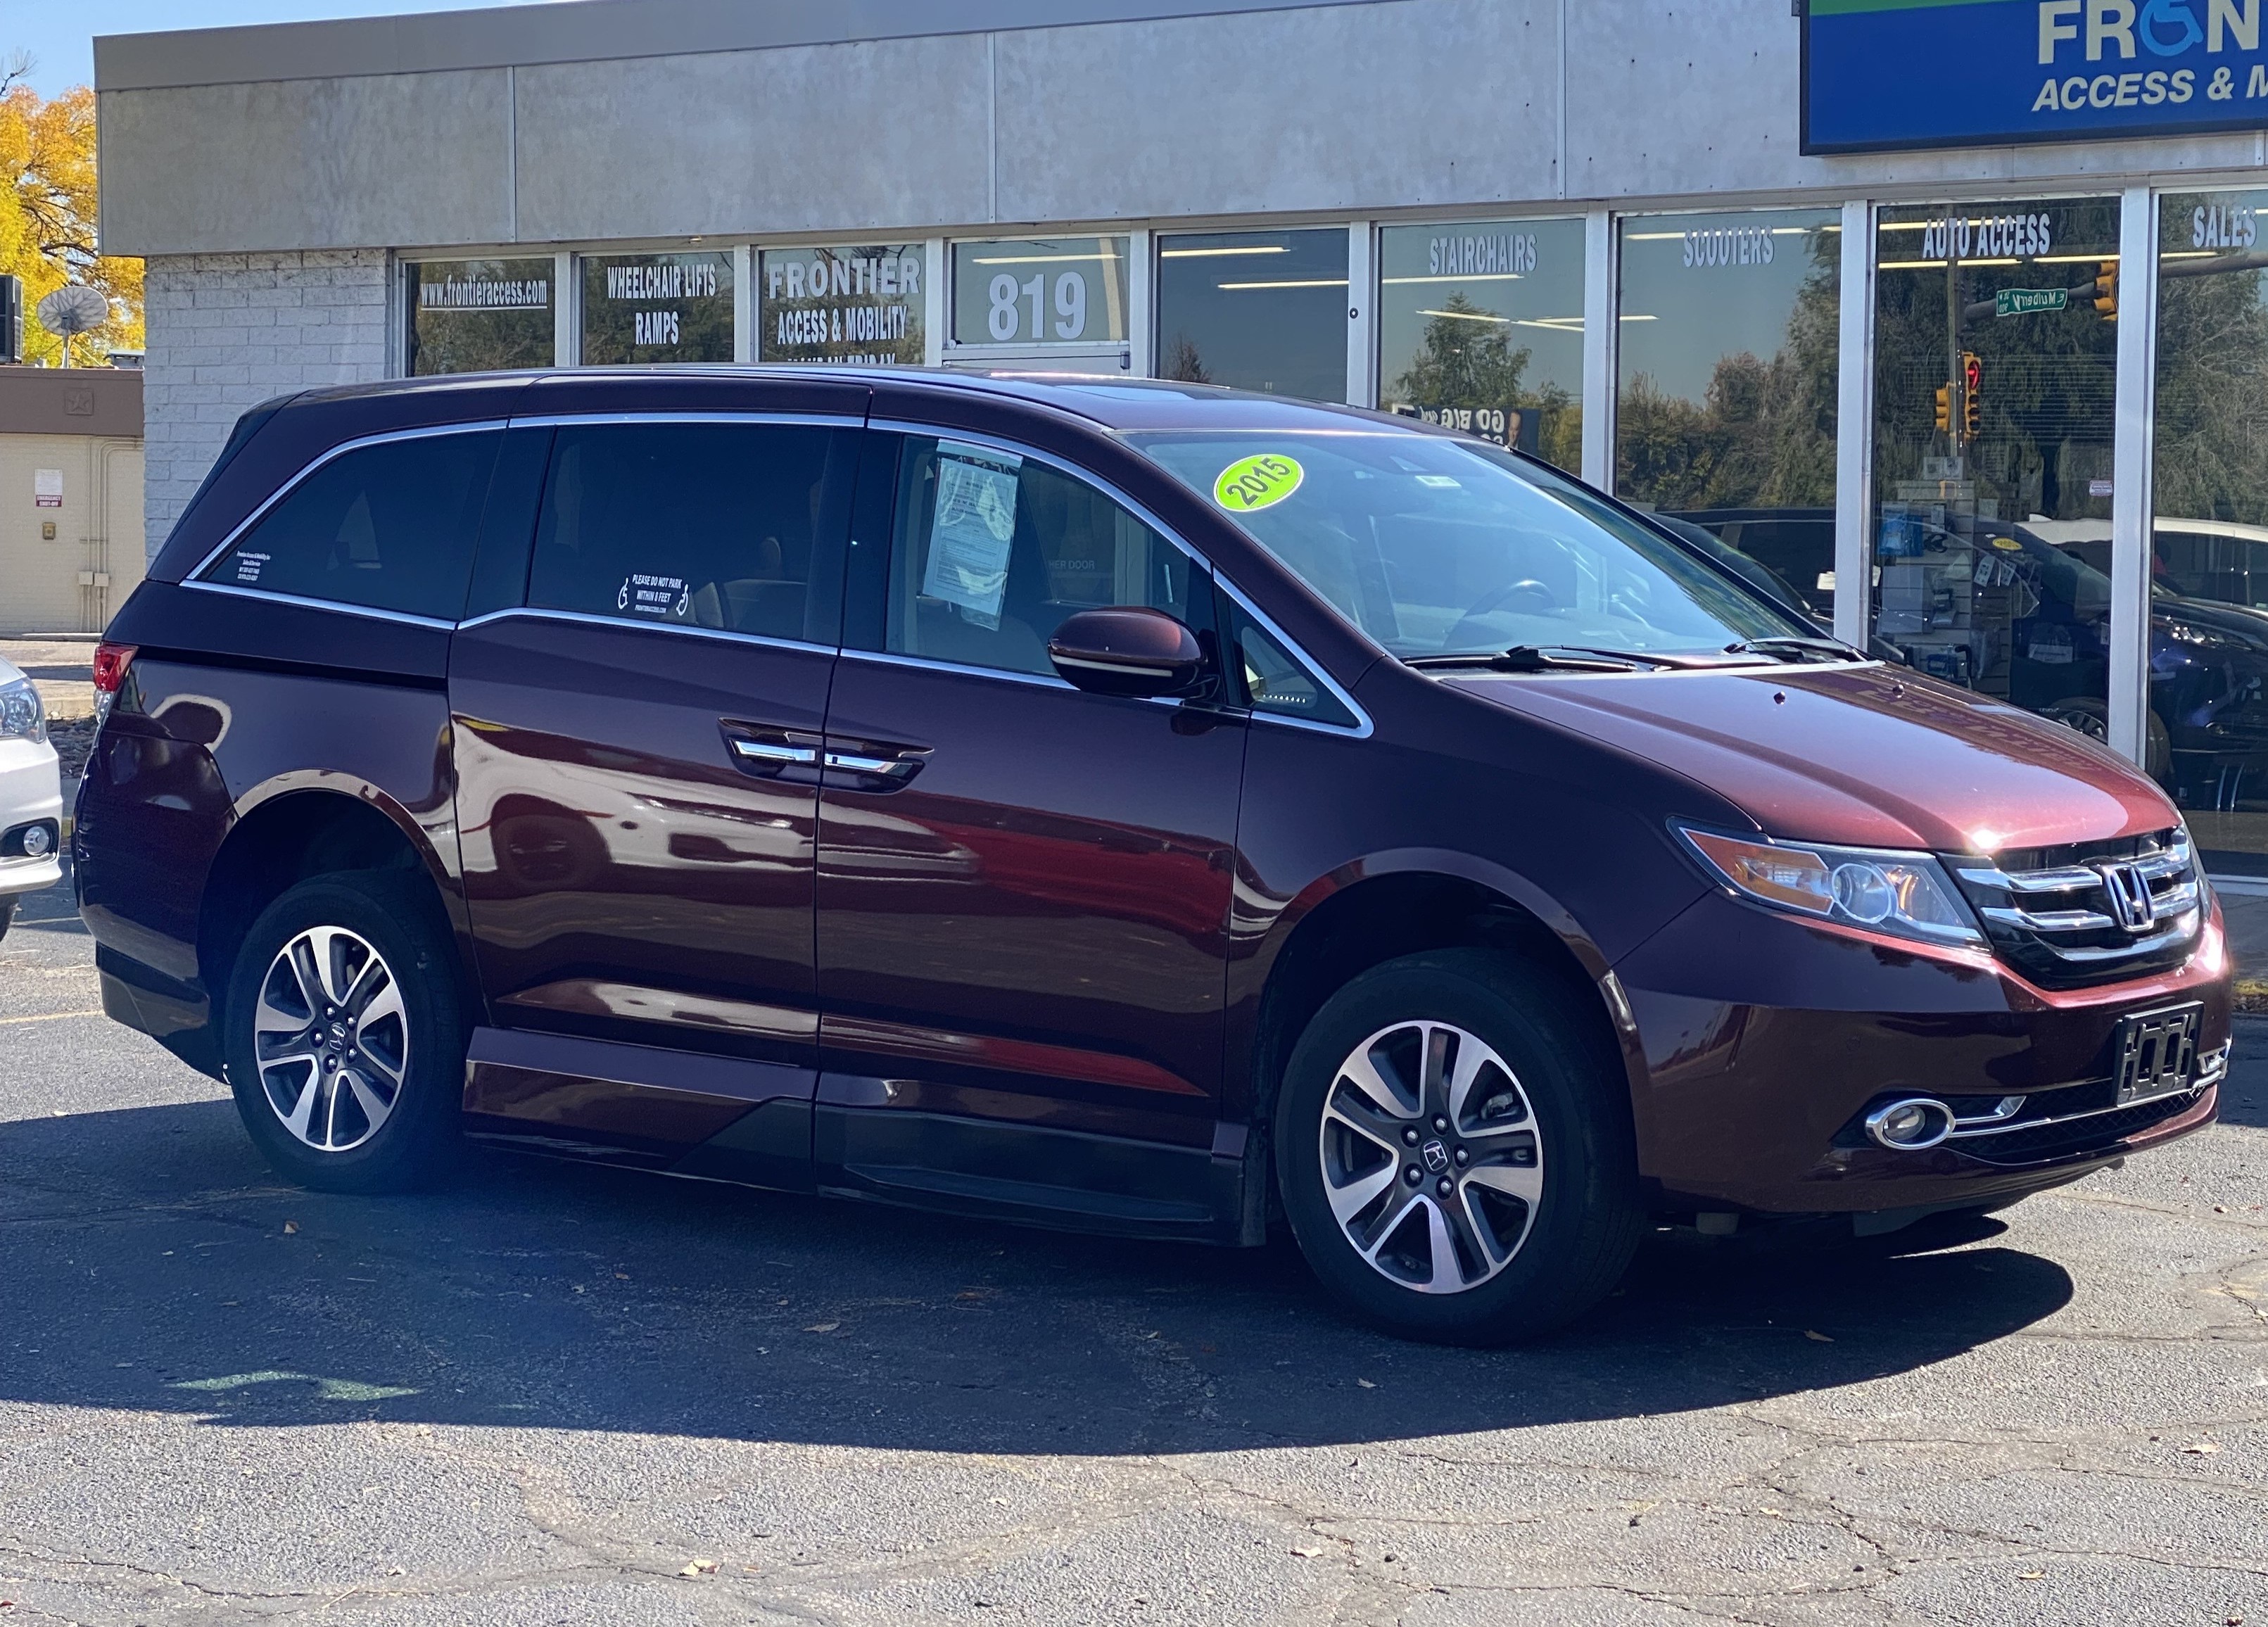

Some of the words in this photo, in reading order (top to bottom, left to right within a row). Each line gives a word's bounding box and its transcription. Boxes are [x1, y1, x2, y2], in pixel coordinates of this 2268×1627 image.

[2031, 69, 2196, 112] ACCESS
[2207, 66, 2235, 101] &
[1683, 224, 1775, 268] SCOOTERS
[1923, 216, 1971, 258] AUTO
[1976, 213, 2051, 257] ACCESS
[2193, 206, 2257, 248] SALES
[1430, 233, 1538, 275] STAIRCHAIRS
[422, 274, 547, 306] www.frontieraccess.com
[607, 265, 683, 299] WHEELCHAIR
[685, 262, 716, 297] LIFTS
[768, 257, 921, 299] FRONTIER
[778, 308, 828, 345] ACCESS
[831, 309, 842, 342] &
[845, 305, 908, 341] MOBILITY
[988, 271, 1087, 341] 819
[635, 311, 679, 346] RAMPS
[1226, 457, 1291, 506] 2015
[632, 574, 651, 585] PLEASE
[650, 576, 659, 585] DO
[658, 576, 669, 587] NOT
[669, 578, 682, 588] PARK
[1068, 559, 1096, 570] DOOR
[636, 590, 654, 600] WITHIN
[658, 592, 671, 602] FEET
